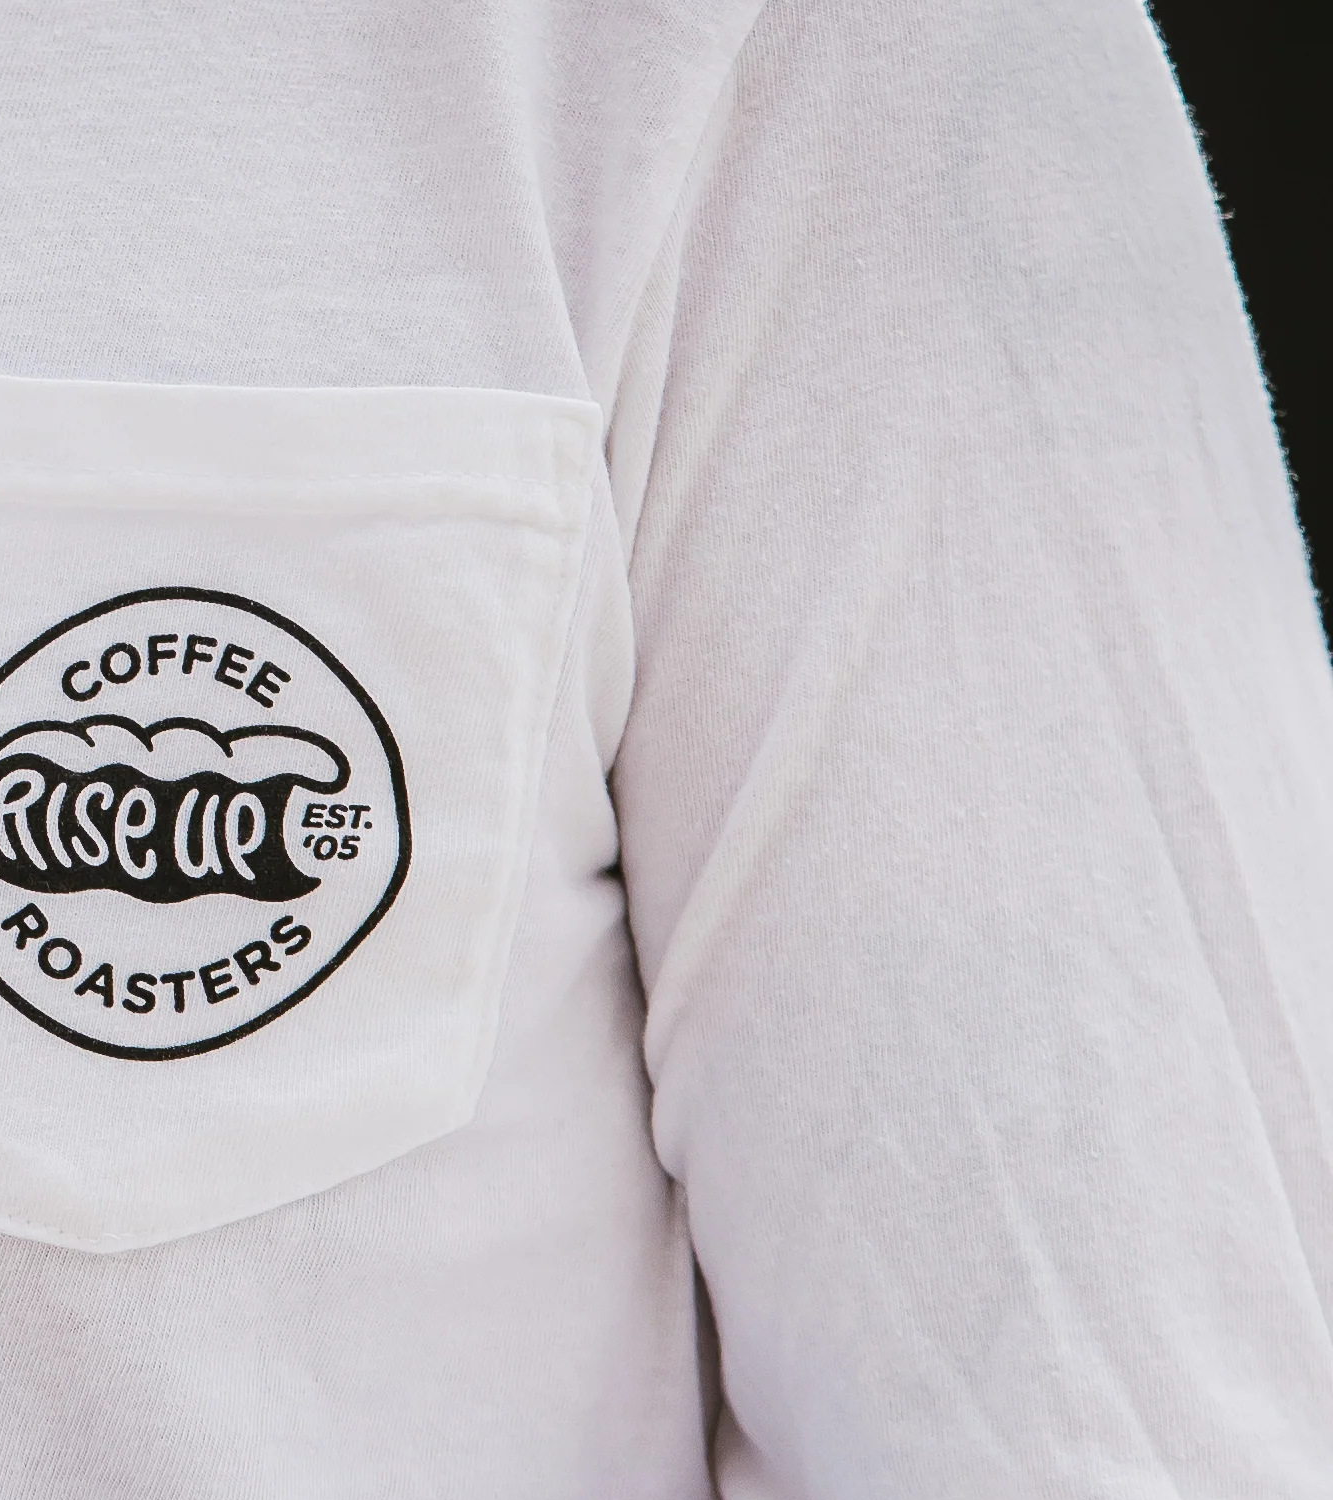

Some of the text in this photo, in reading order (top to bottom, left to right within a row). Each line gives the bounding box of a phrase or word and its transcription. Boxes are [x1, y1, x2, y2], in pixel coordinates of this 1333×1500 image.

[61, 633, 291, 709] COFFEE
[300, 803, 373, 830] EST.
[0, 902, 312, 1014] ROASTERS
